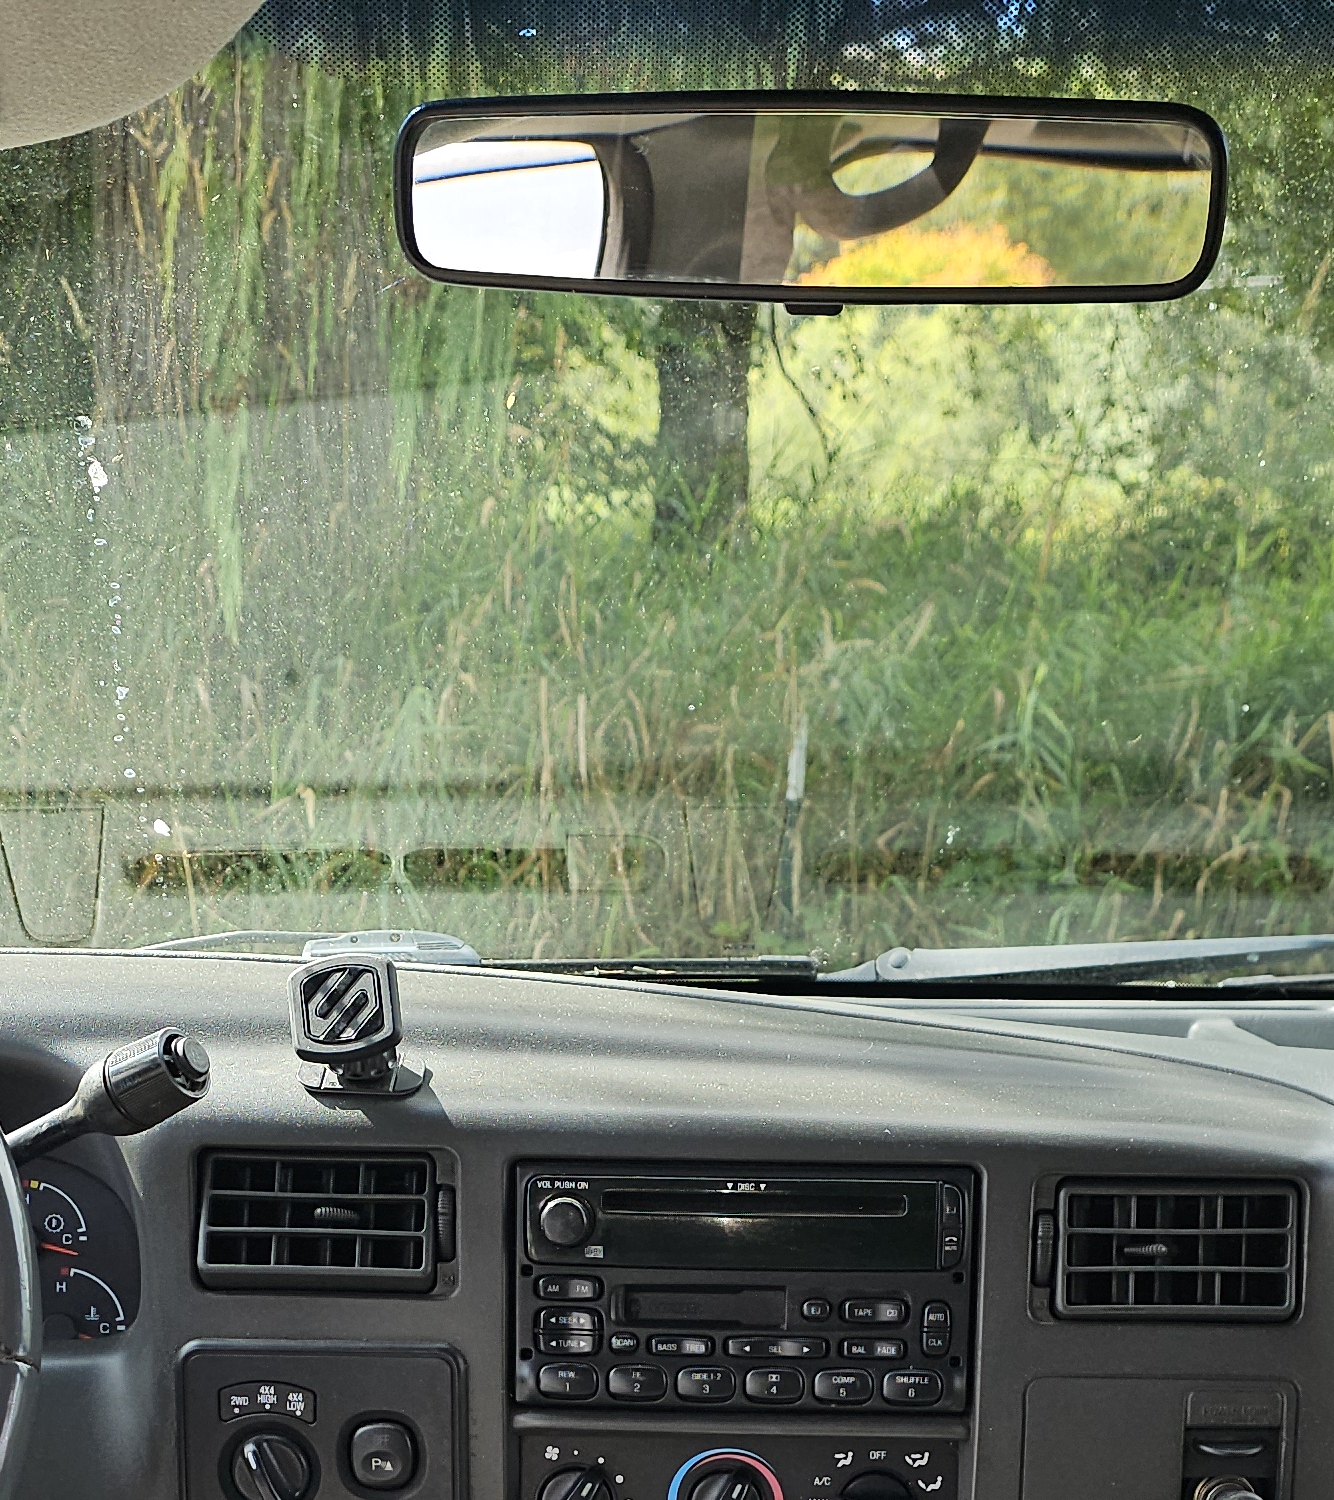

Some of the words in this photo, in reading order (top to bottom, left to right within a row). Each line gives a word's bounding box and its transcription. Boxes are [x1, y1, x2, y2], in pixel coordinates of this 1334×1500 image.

[536, 1181, 553, 1189] VOL
[554, 1181, 576, 1189] PUSH
[577, 1181, 589, 1190] ON
[737, 1183, 756, 1191] DISC
[62, 1233, 73, 1245] C
[56, 1281, 67, 1293] H
[547, 1285, 560, 1293] AM
[576, 1285, 589, 1293] FM
[810, 1307, 821, 1315] EJ
[854, 1308, 873, 1317] TAPE
[886, 1309, 898, 1317] CD
[558, 1316, 578, 1324] SEEK
[928, 1313, 945, 1321] AUTO
[99, 1322, 110, 1334] C
[558, 1340, 579, 1348] TUNE
[614, 1338, 635, 1346] SCAN
[928, 1339, 943, 1347] CLK
[657, 1343, 678, 1351] BASS
[769, 1345, 782, 1353] SEL
[851, 1346, 866, 1354] BAL
[877, 1346, 896, 1354] FADE
[558, 1371, 576, 1379] REW
[832, 1376, 856, 1384] COMP
[895, 1376, 929, 1384] SHUFFLE
[259, 1385, 275, 1395] 4X4
[633, 1383, 641, 1393] 2
[702, 1384, 710, 1394] 3
[770, 1386, 777, 1395] 4
[839, 1388, 846, 1397] 5
[908, 1388, 915, 1398] 6
[230, 1396, 249, 1406] 2WD
[257, 1394, 278, 1404] HIGH
[287, 1393, 303, 1402] 4X4
[286, 1401, 305, 1411] LOW
[869, 1450, 887, 1460] OFF
[813, 1476, 832, 1486] A/C
